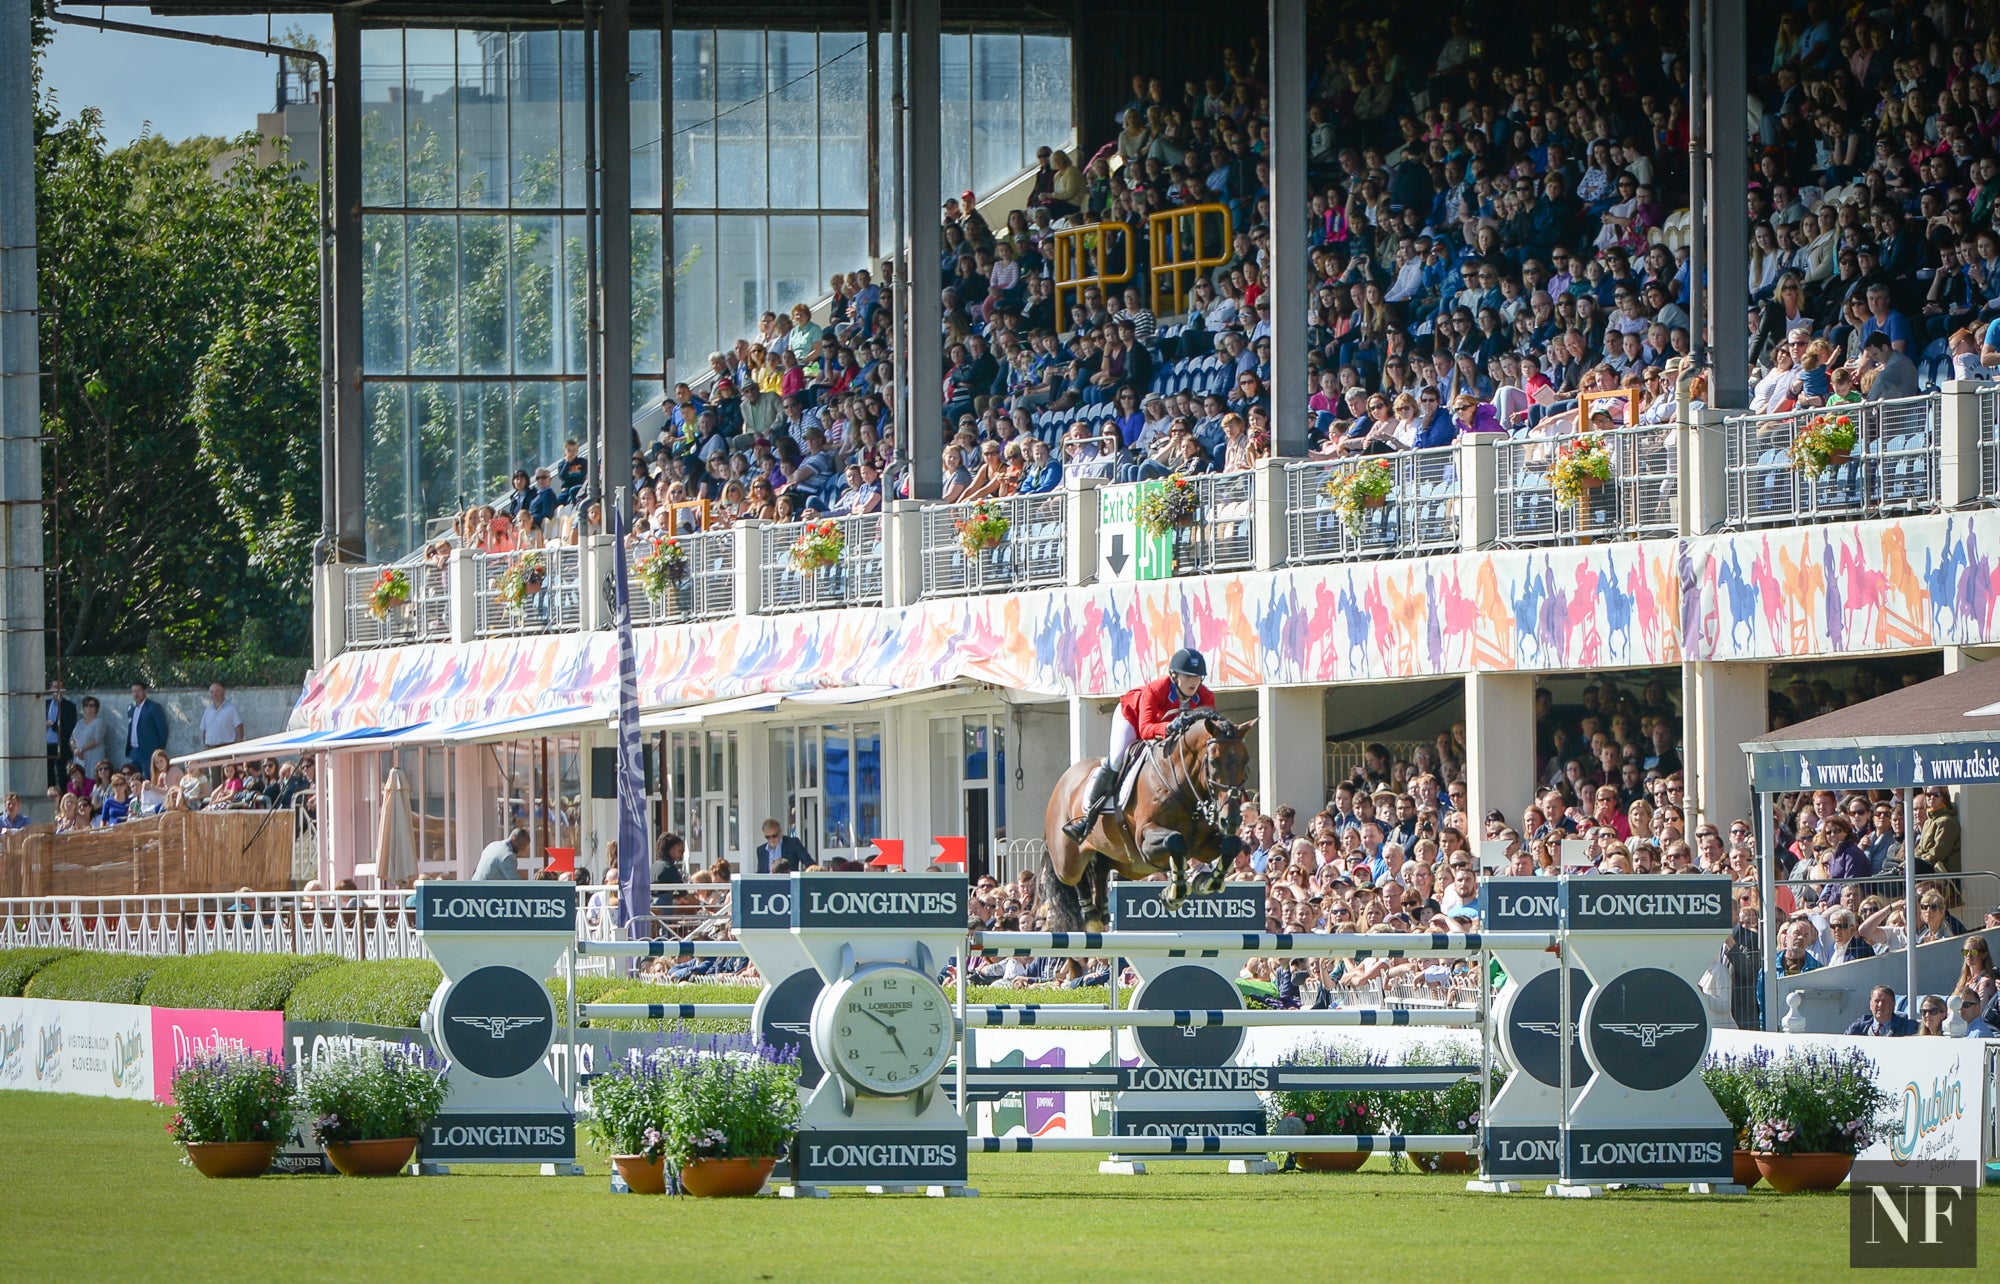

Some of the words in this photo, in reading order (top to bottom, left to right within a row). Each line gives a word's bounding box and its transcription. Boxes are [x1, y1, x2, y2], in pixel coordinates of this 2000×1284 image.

[1103, 492, 1124, 525] Exit
[1127, 492, 1134, 522] 8
[1817, 755, 1884, 784] www.rds.ie
[1930, 749, 2000, 779] www.rds.ie
[432, 897, 567, 919] LONGINES
[810, 892, 958, 915] LONGINES
[1126, 898, 1256, 919] LONGINES
[1578, 893, 1722, 916] LONGINES
[883, 979, 898, 990] 12
[911, 985, 916, 995] 1
[864, 986, 873, 997] 11
[848, 1003, 862, 1013] 10
[868, 1001, 913, 1010] LONGINES
[923, 1001, 934, 1011] 2
[841, 1027, 852, 1037] 9
[930, 1024, 941, 1034] 3
[848, 1049, 860, 1060] 8
[923, 1047, 934, 1057] 4
[865, 1066, 876, 1076] 7
[909, 1065, 919, 1075] 5
[887, 1071, 897, 1082] 6
[1127, 1068, 1269, 1090] LONGINES
[1890, 1075, 1965, 1168] Dublin
[432, 1125, 566, 1147] LONGINES
[809, 1144, 957, 1167] LONGINES
[1580, 1142, 1722, 1165] LONGINES
